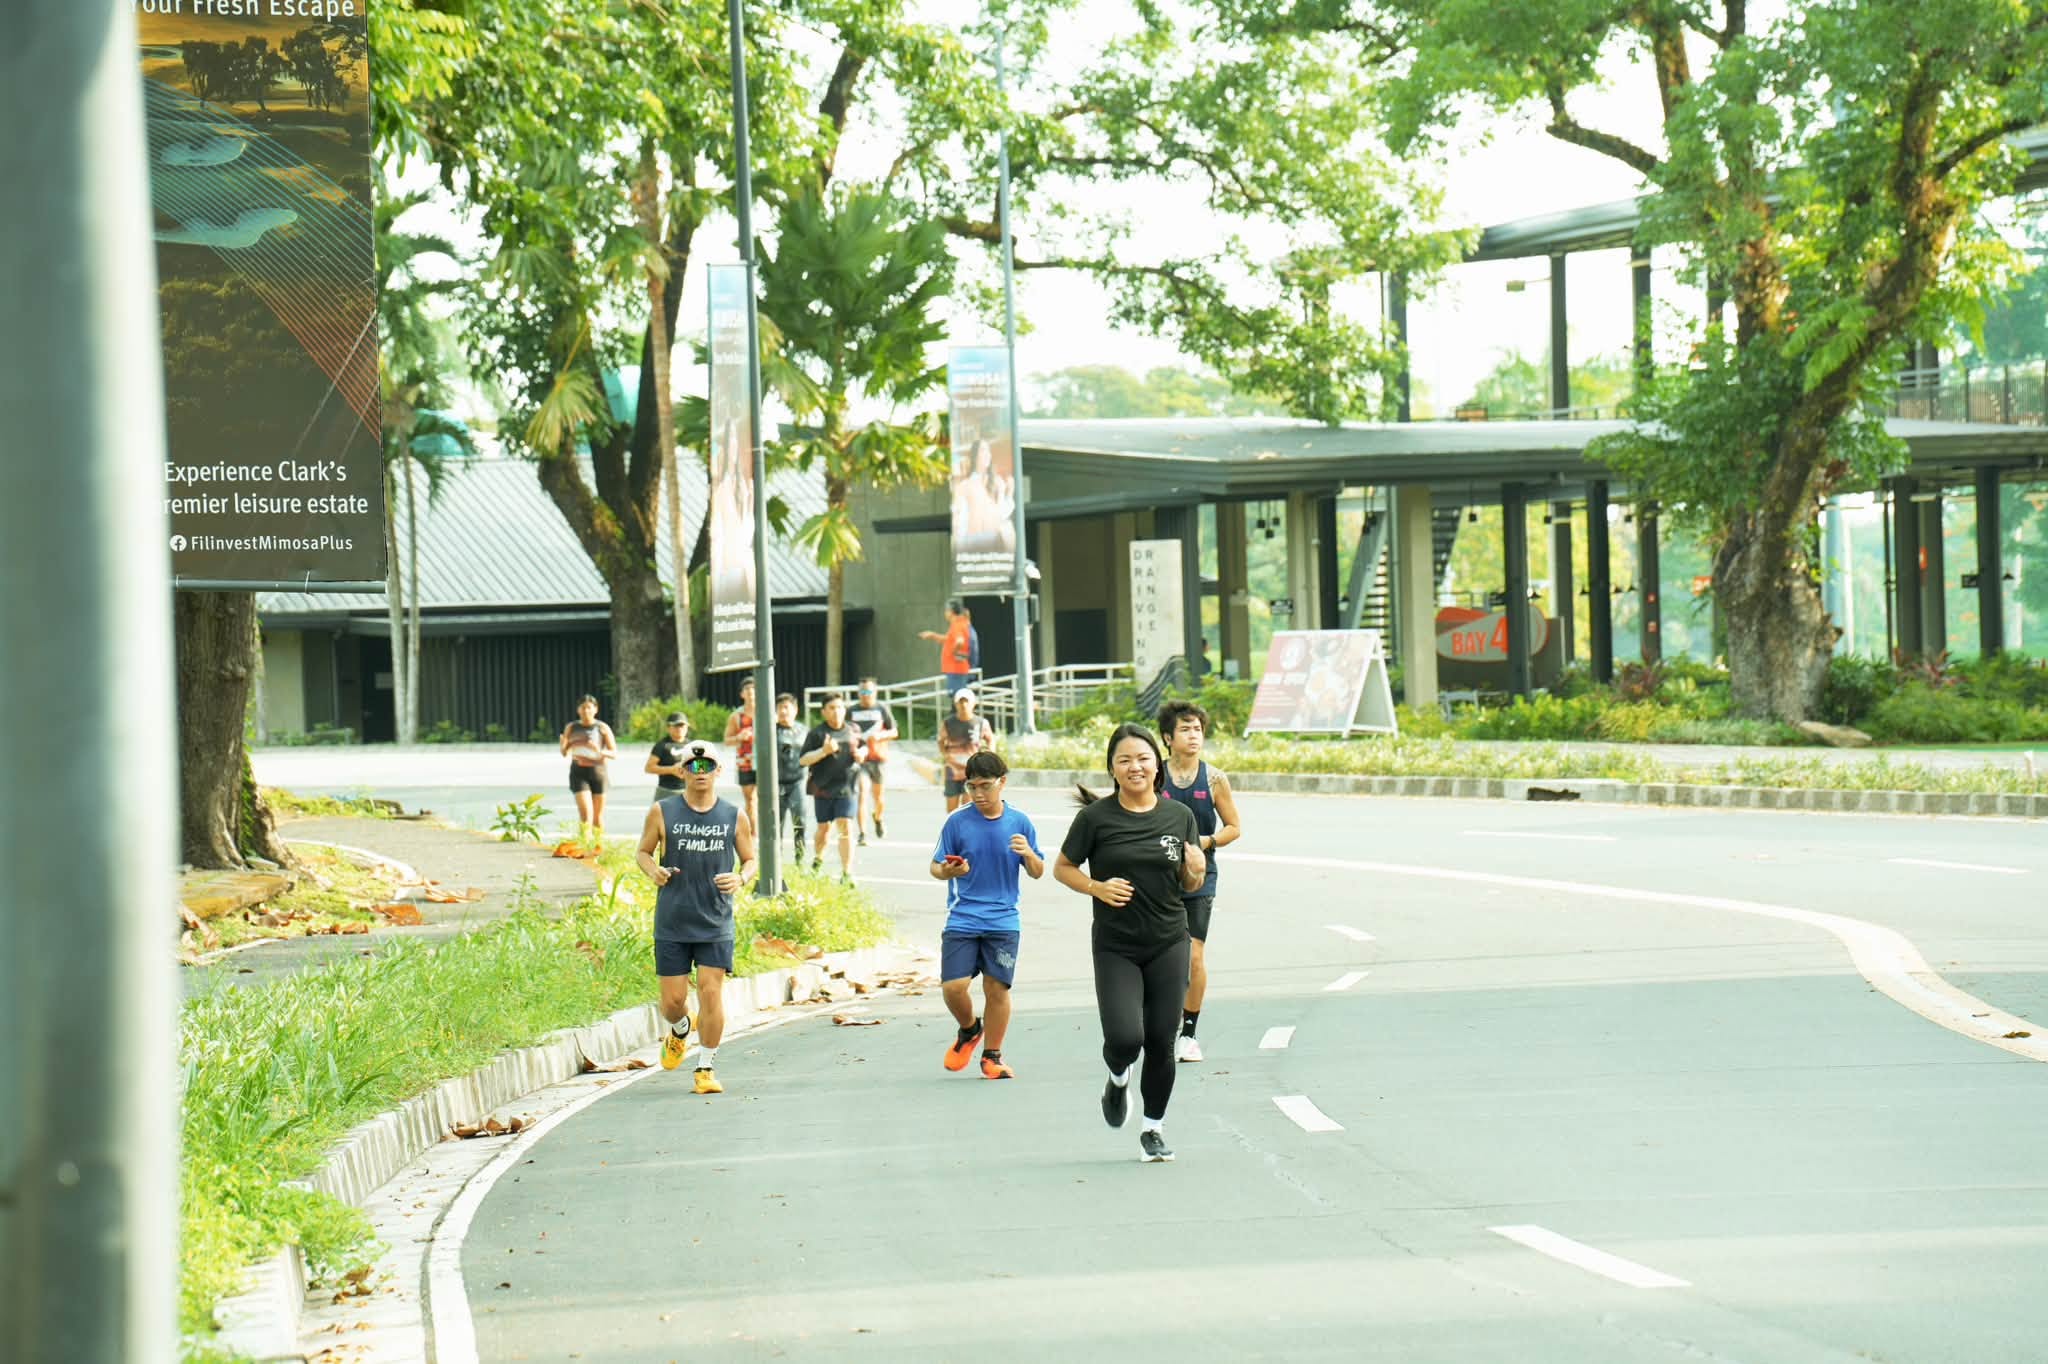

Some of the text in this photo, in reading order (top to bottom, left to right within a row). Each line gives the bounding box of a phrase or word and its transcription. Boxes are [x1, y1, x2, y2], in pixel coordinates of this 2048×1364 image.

[193, 0, 260, 15] Fresh
[271, 0, 355, 22] Escape
[164, 461, 273, 487] Experience
[162, 492, 369, 514] remier leisure estate
[191, 535, 353, 551] FilinvestMimosaPlus
[1133, 549, 1147, 667] DRIVING
[1452, 616, 1509, 656] BAY 4
[672, 823, 730, 837] STRANGELY
[677, 839, 725, 852] FAMILIAR
